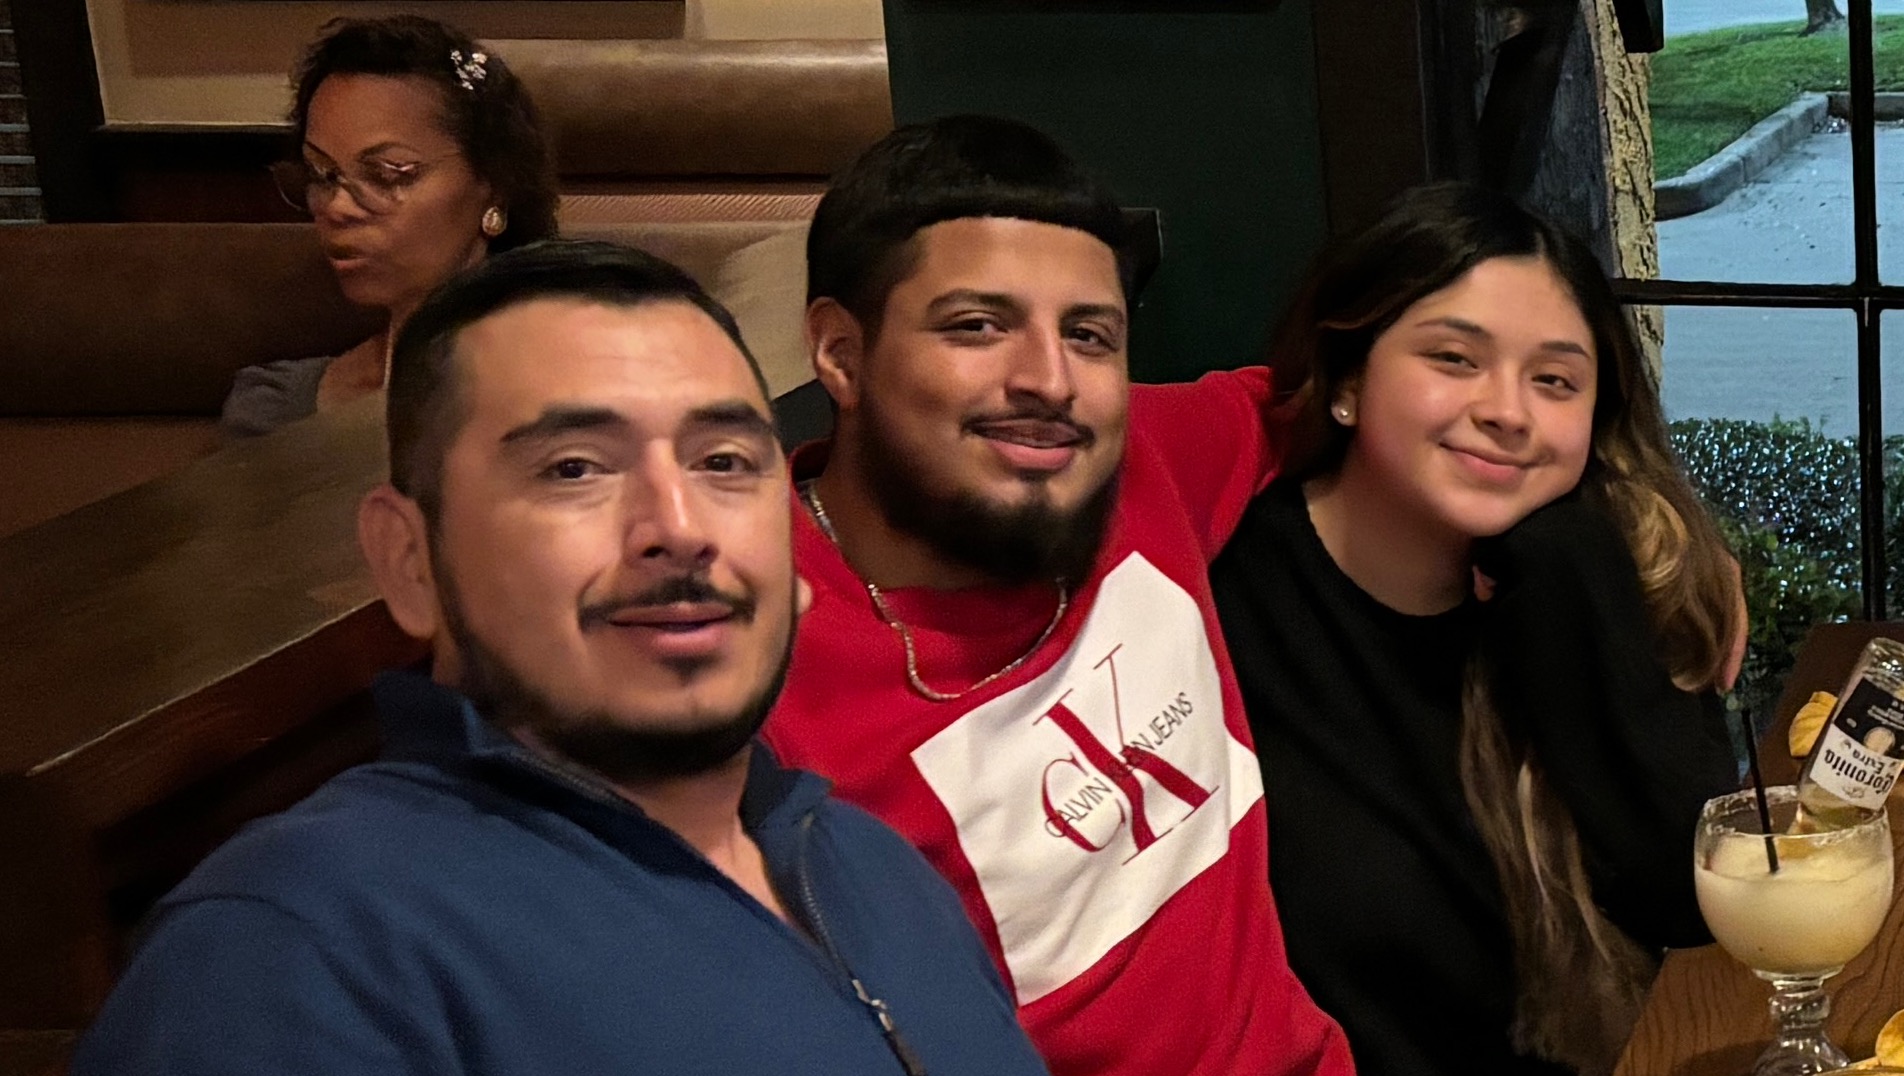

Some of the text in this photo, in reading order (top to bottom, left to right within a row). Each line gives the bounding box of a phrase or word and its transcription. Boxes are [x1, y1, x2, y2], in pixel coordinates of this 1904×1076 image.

[1045, 691, 1194, 838] CALVIN JEANS
[1823, 748, 1895, 795] Coronita
[1852, 748, 1885, 775] Extra
